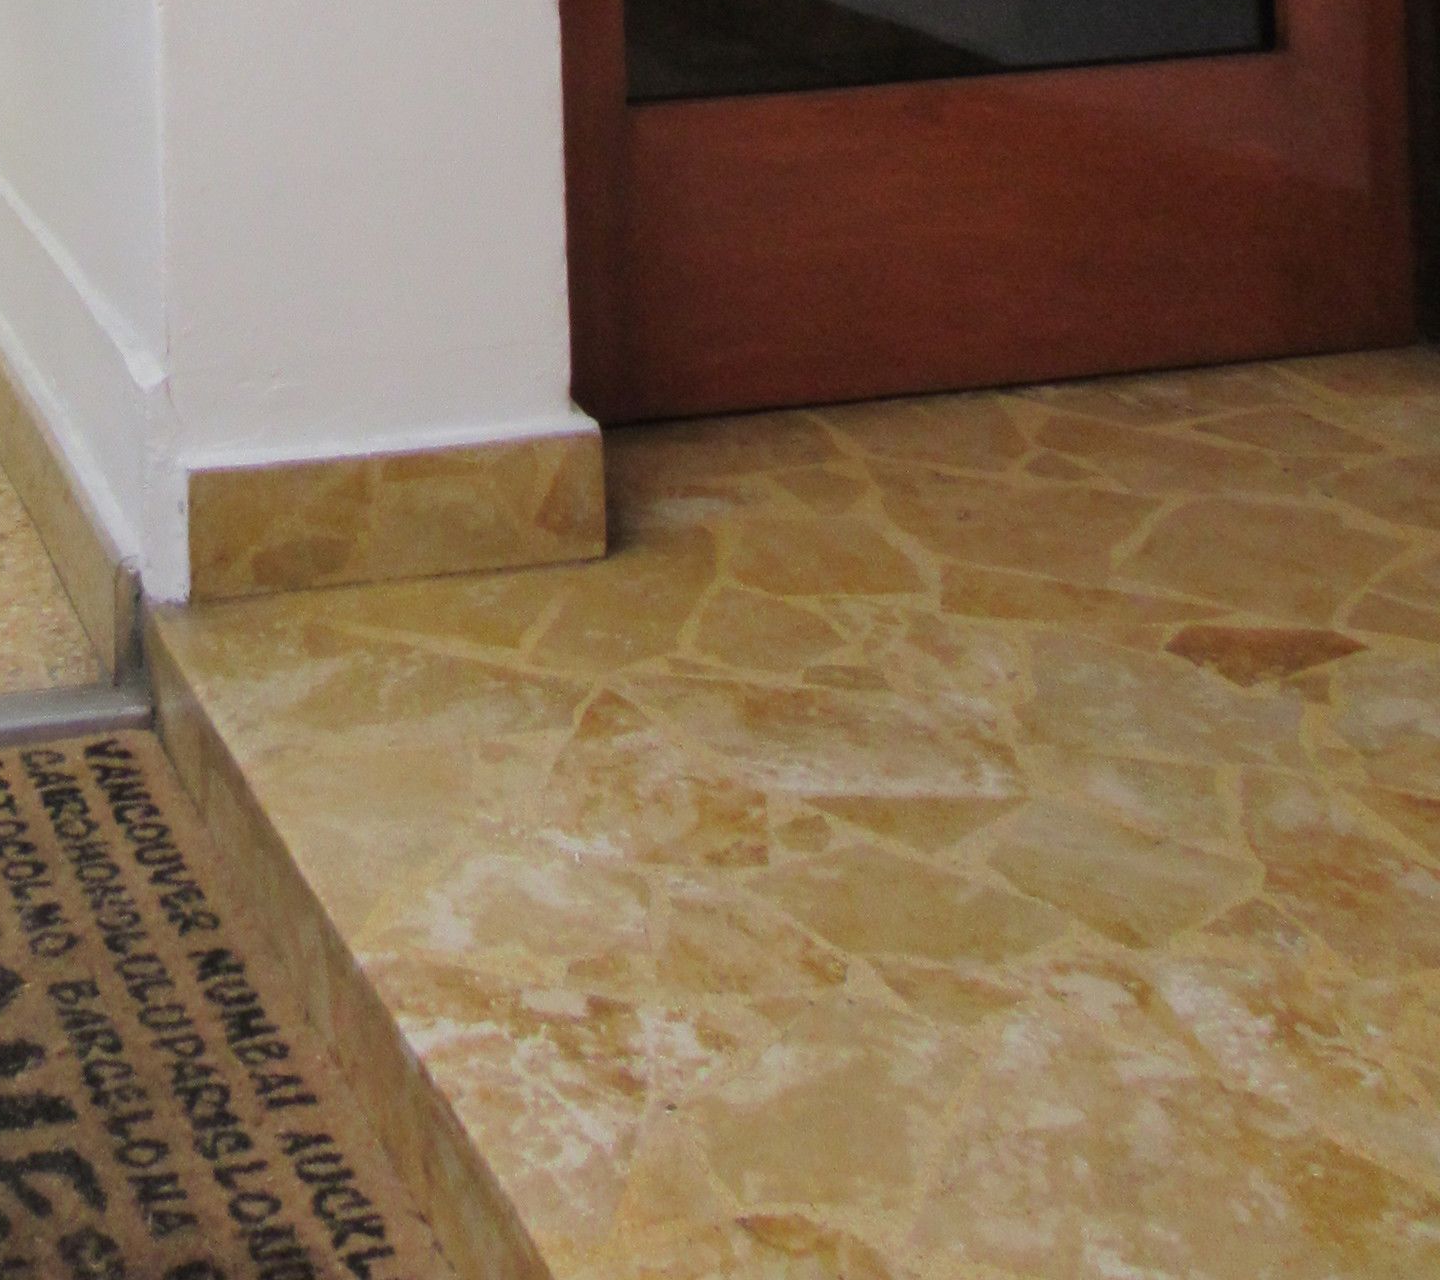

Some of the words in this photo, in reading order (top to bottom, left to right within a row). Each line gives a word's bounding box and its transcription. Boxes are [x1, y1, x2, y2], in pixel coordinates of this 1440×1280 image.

[20, 750, 99, 842] CAIRO
[63, 841, 194, 1032] HONOLULU
[151, 1033, 253, 1160] PARIS
[46, 978, 199, 1237] BARCELONA
[83, 738, 221, 936] VANCOUVER
[186, 946, 318, 1110] MUMBAI
